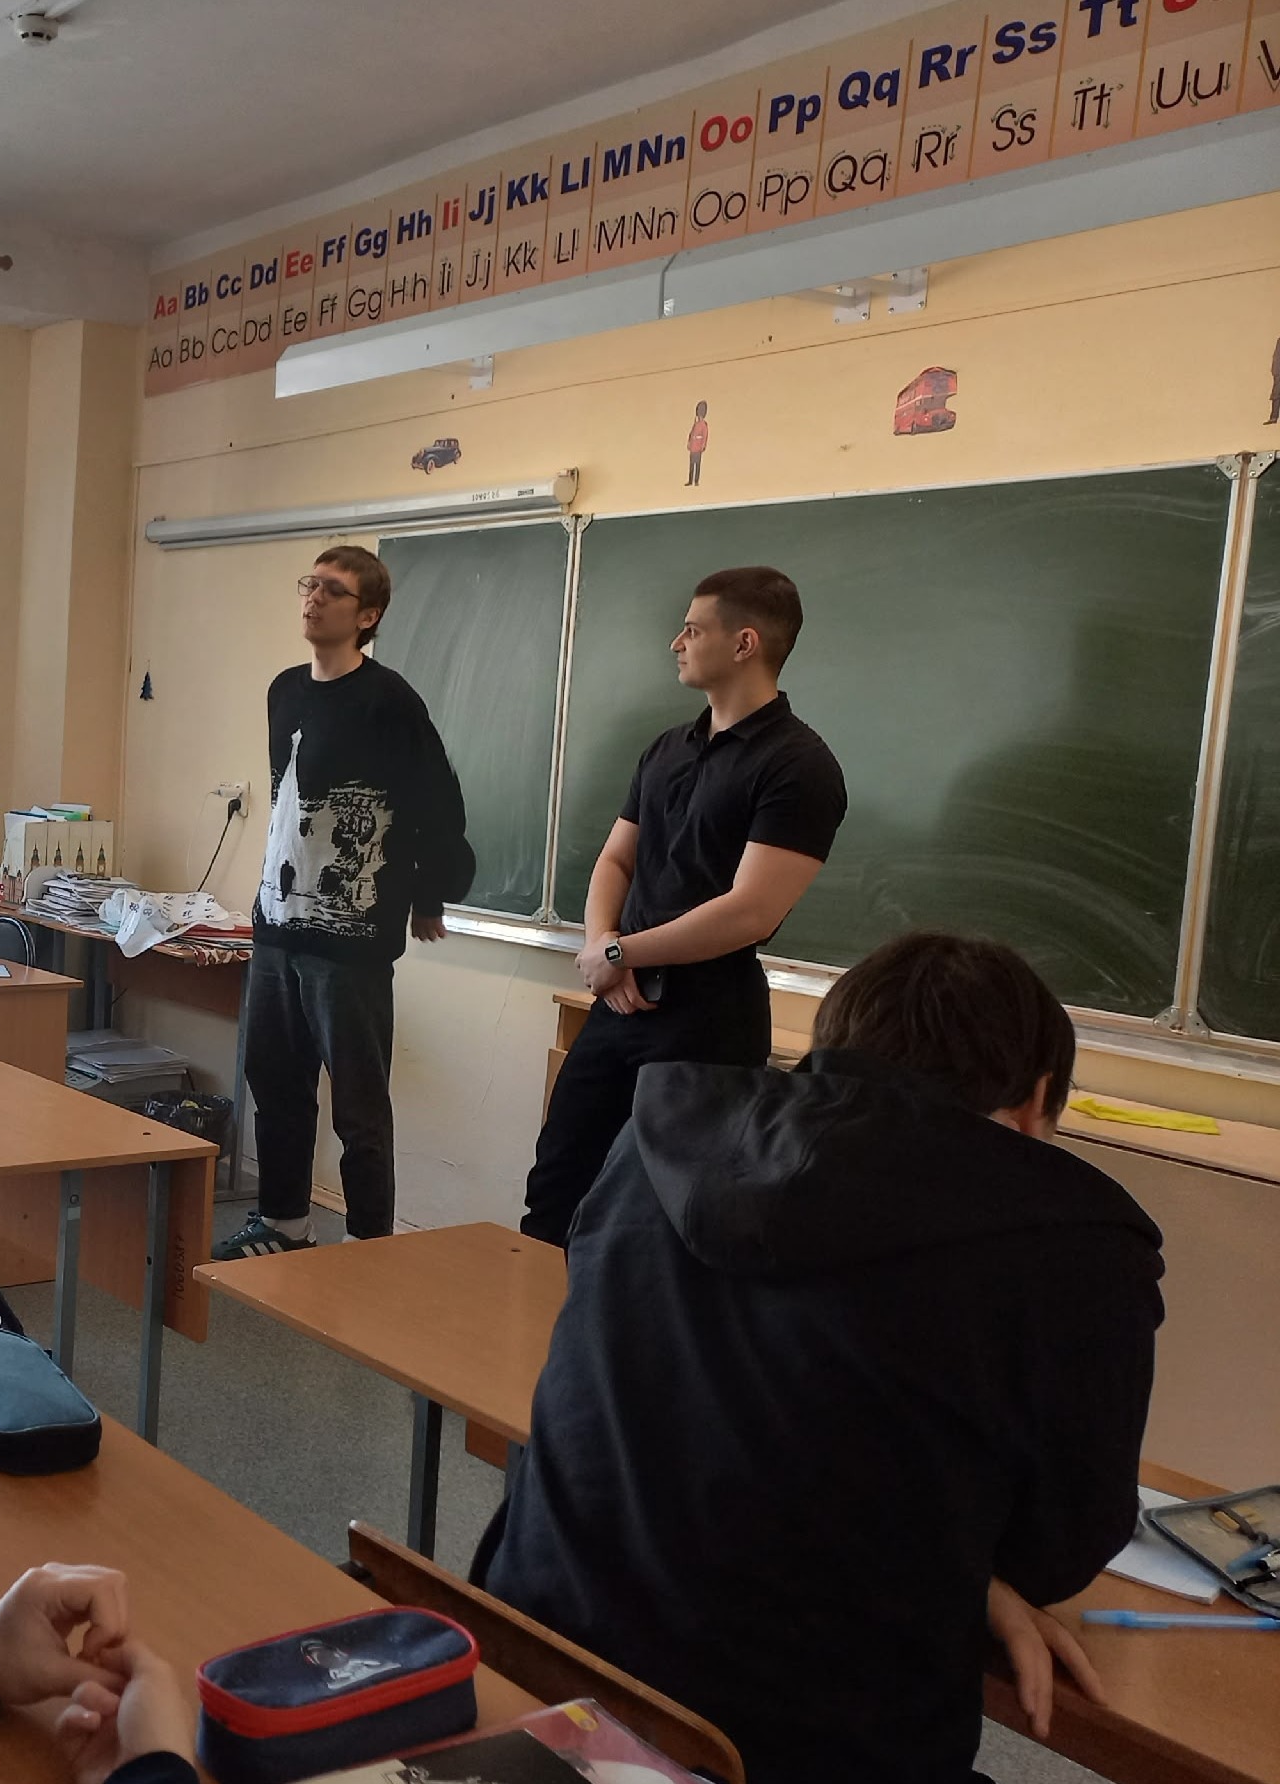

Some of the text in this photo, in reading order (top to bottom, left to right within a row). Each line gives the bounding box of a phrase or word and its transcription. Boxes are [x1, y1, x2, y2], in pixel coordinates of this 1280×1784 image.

[148, 347, 173, 372] Aa
[179, 335, 205, 364] Bb
[211, 328, 238, 355] Cc
[243, 314, 272, 346] Dd
[283, 308, 308, 336] Ee
[319, 294, 338, 327] Ff
[348, 288, 382, 320] Gg
[390, 272, 427, 308] Hh
[439, 262, 453, 296] Ii
[466, 252, 492, 290] Jj
[505, 241, 537, 278] Kk
[556, 228, 579, 265] Ll
[693, 190, 747, 228] Oo
[762, 173, 811, 215] Pp
[827, 152, 888, 193] Qq
[915, 130, 957, 173] Rr
[992, 108, 1037, 152] Ss
[1073, 82, 1112, 131] Tt
[1155, 60, 1226, 110] Uu
[153, 295, 178, 319] Aa
[183, 282, 209, 310] Bb
[216, 274, 242, 300] Cc
[250, 258, 278, 290] Dd
[285, 251, 313, 279] Ee
[322, 234, 347, 267] Ff
[354, 228, 388, 258] Gg
[397, 208, 432, 245] Hh
[442, 197, 460, 231] Ii
[469, 186, 496, 225] Jj
[506, 172, 548, 210] Kk
[560, 156, 590, 195] Ll
[700, 115, 754, 152] Oo
[768, 94, 821, 135] Pp
[838, 68, 901, 110] Qq
[918, 44, 978, 89] Rr
[992, 20, 1057, 65] Ss
